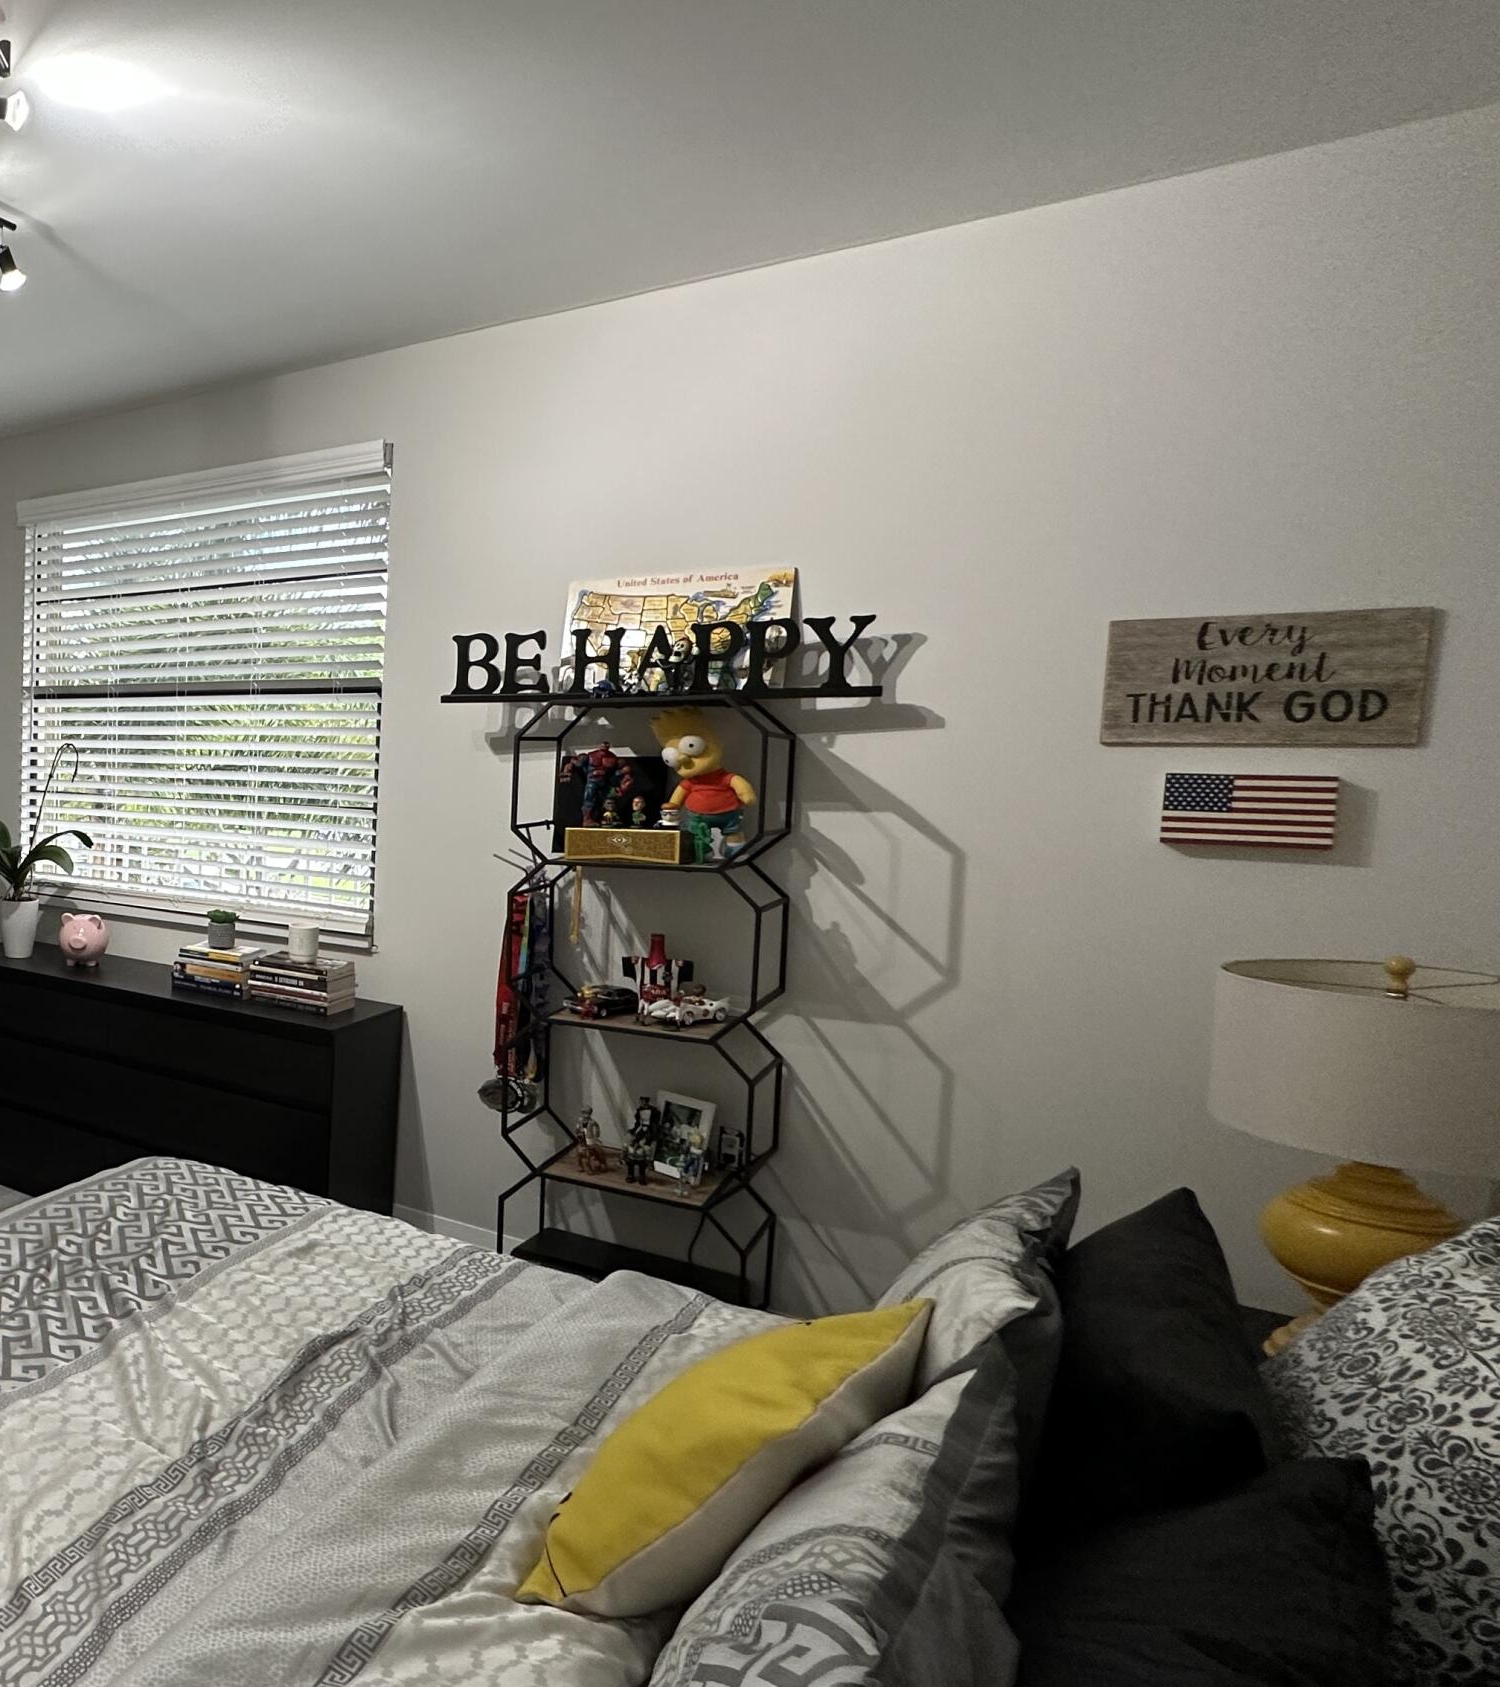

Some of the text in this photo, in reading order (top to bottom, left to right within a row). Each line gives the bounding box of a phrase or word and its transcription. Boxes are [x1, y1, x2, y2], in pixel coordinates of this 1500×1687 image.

[618, 572, 740, 588] United States of America
[452, 614, 877, 696] BE HAPPY
[1196, 621, 1316, 656] Every
[1171, 651, 1336, 685] Moment
[1126, 688, 1390, 724] THANK GOD
